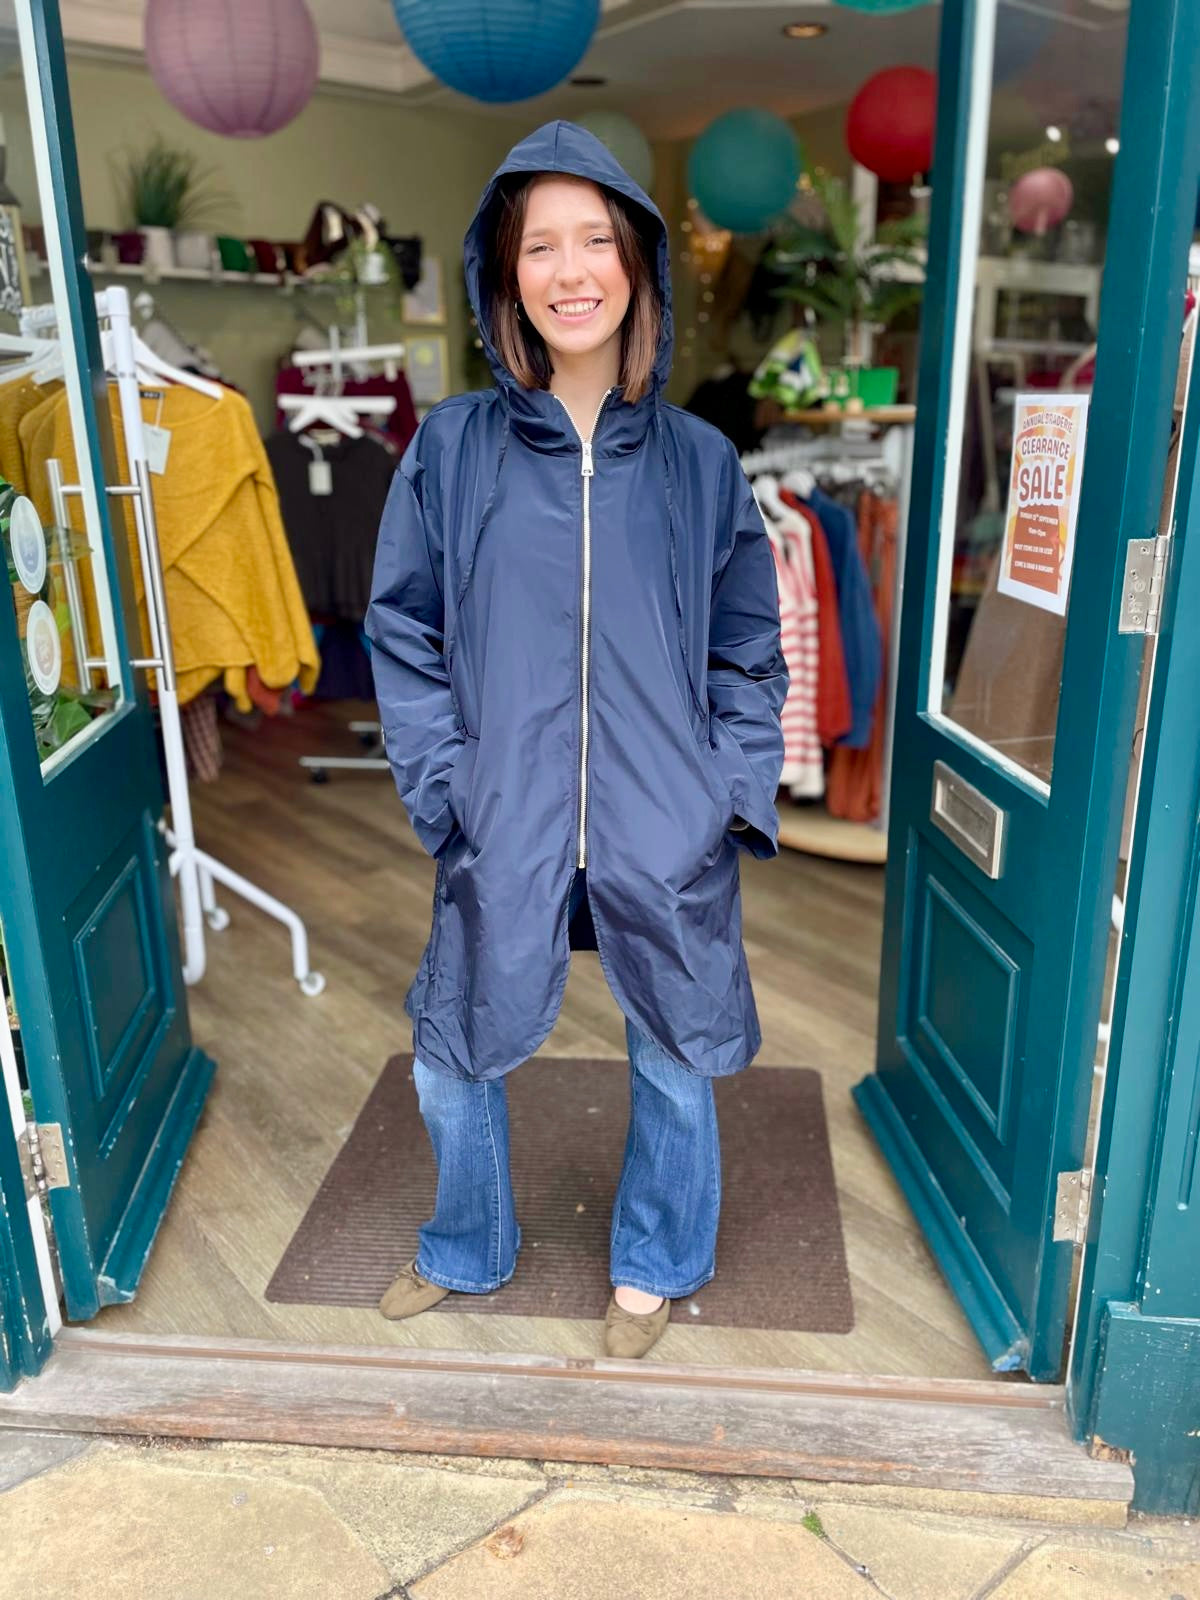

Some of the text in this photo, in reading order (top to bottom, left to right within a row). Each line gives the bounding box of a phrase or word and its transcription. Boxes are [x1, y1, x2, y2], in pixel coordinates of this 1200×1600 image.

[1023, 412, 1044, 430] ANNUAL
[1021, 438, 1071, 460] CLEARANCE
[1019, 464, 1066, 502] SALE
